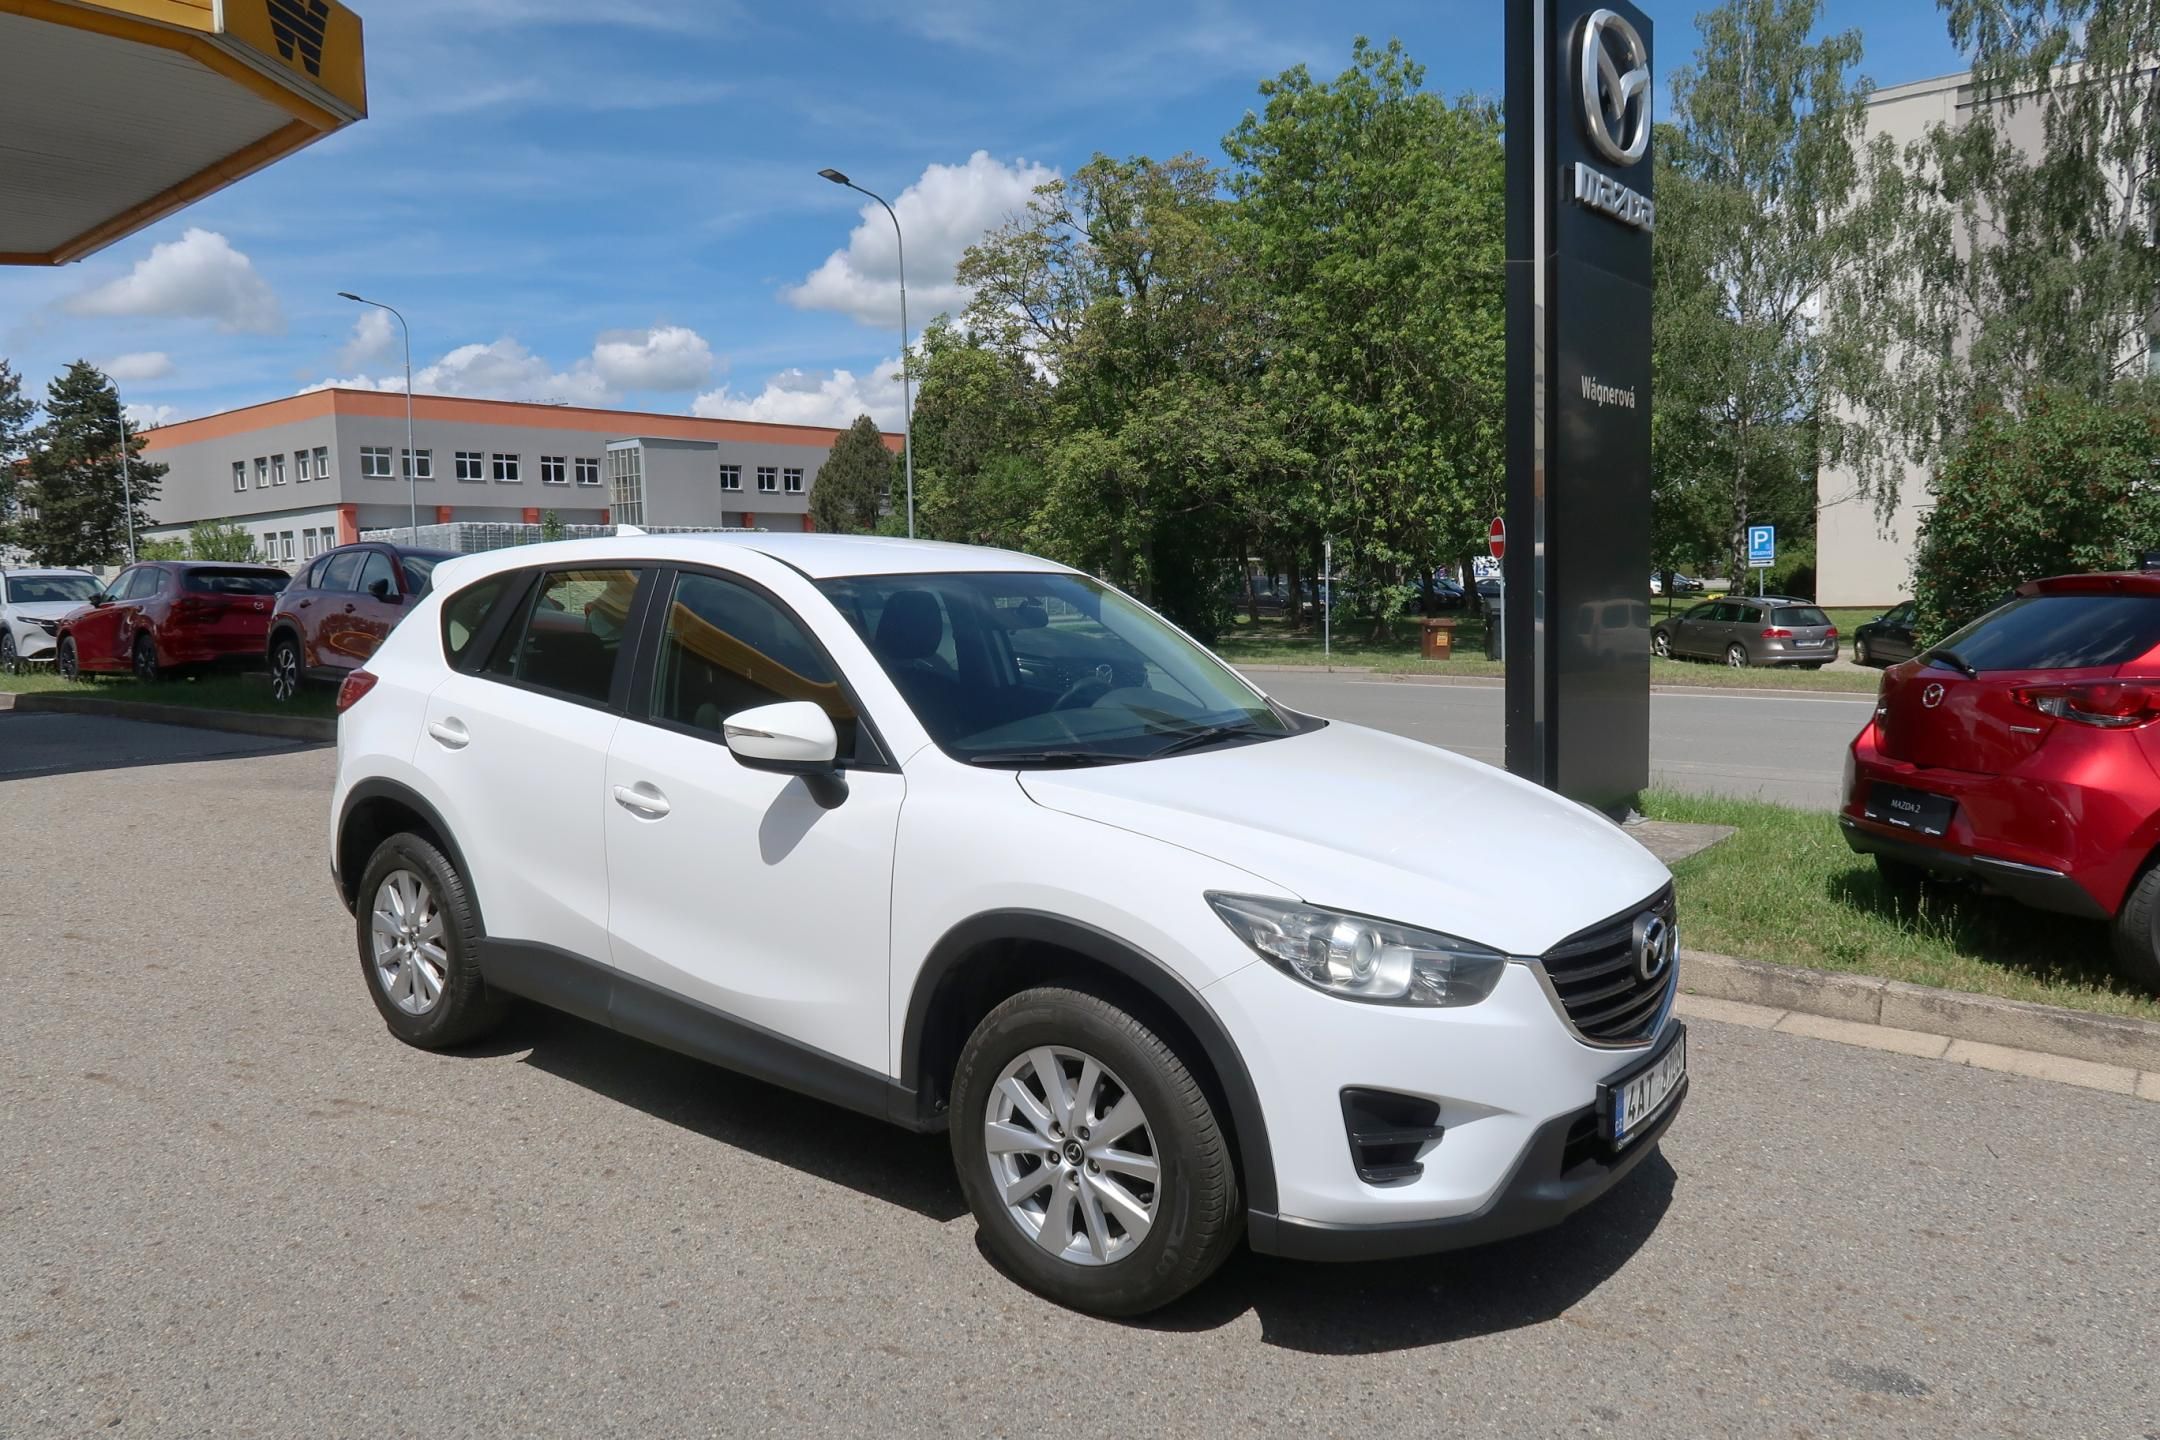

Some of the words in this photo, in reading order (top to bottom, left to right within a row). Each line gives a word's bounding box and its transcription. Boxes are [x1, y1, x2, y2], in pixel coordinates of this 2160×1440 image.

[1581, 375, 1635, 409] Wágnerová
[1754, 530, 1769, 550] P
[1890, 799, 1915, 812] MAZDA
[1915, 804, 1921, 814] 2
[1628, 1072, 1655, 1120] 4AT
